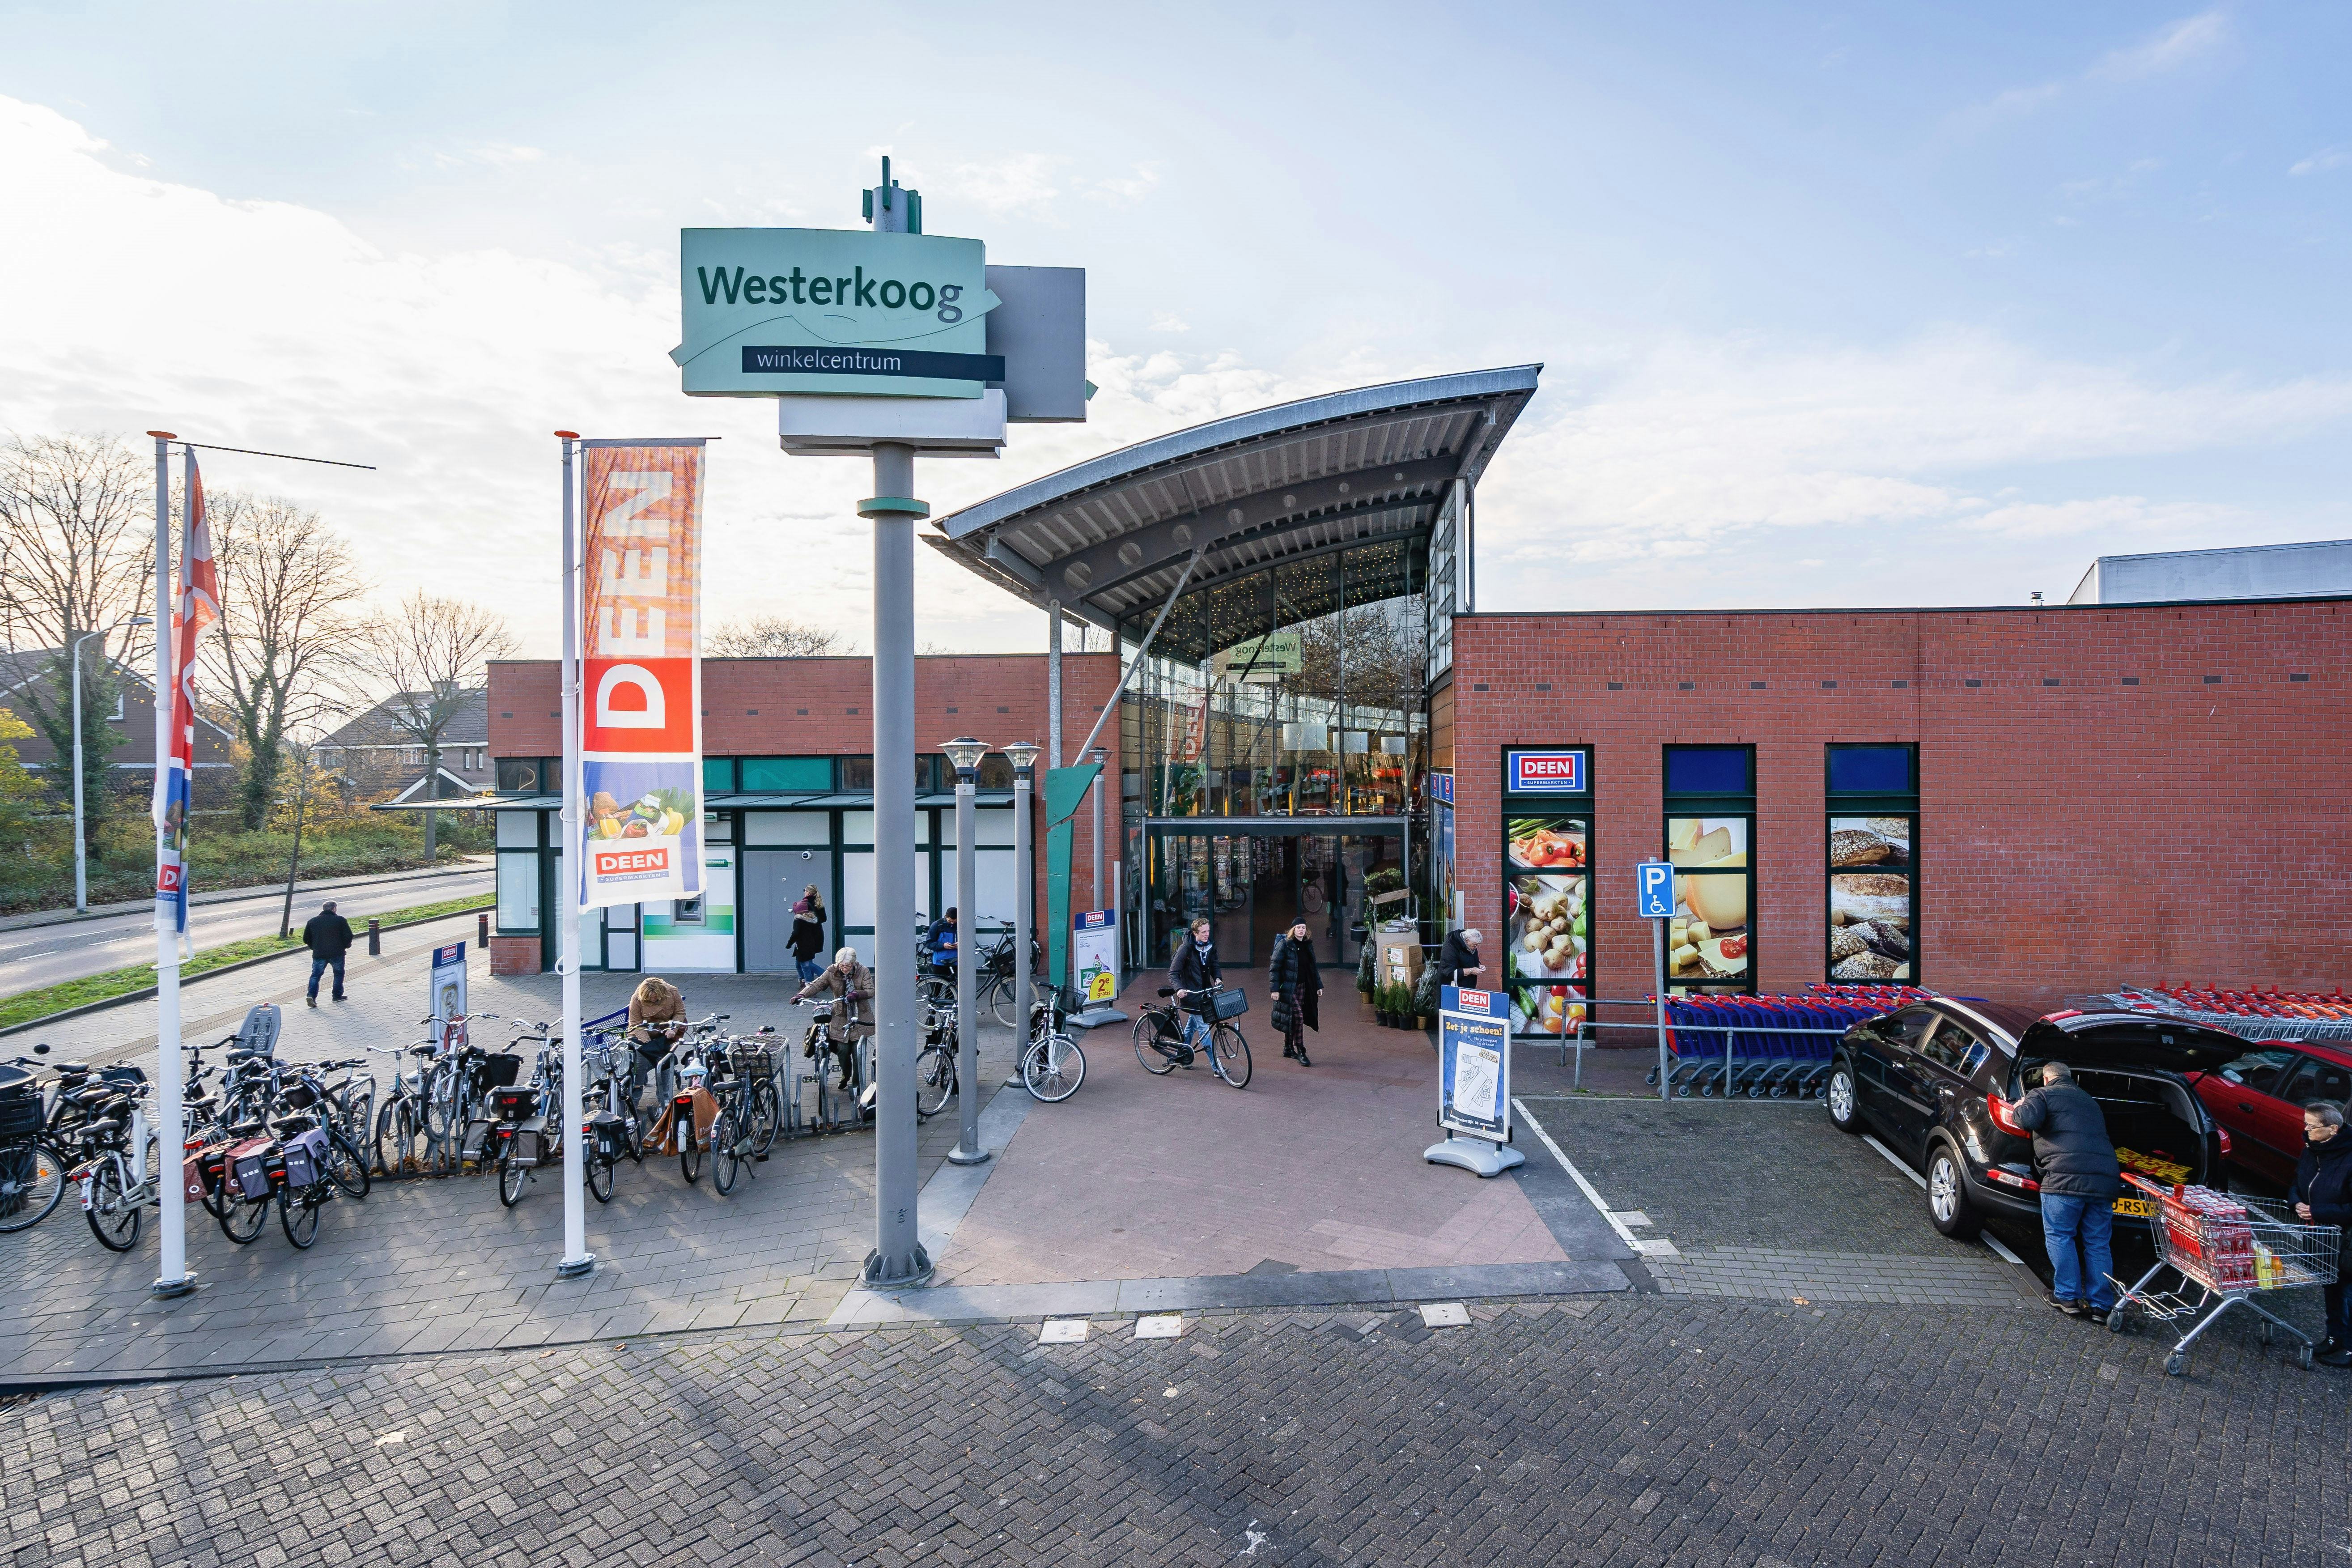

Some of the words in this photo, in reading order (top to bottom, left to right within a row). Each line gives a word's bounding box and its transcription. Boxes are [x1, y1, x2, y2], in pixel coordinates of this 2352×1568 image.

[697, 266, 963, 323] Westerkoog
[757, 349, 901, 371] winkelcentrum
[597, 471, 673, 729] DEEN
[1524, 761, 1570, 774] DEEN
[601, 853, 662, 871] DEEN
[606, 873, 661, 881] SUPERMARKTEN
[1646, 867, 1666, 895] P
[443, 947, 456, 956] DEEN
[1097, 990, 1111, 998] gratis
[1462, 993, 1487, 1005] DEEN
[1445, 1022, 1458, 1031] Zet
[1460, 1023, 1468, 1034] je
[1470, 1025, 1503, 1036] schoen!
